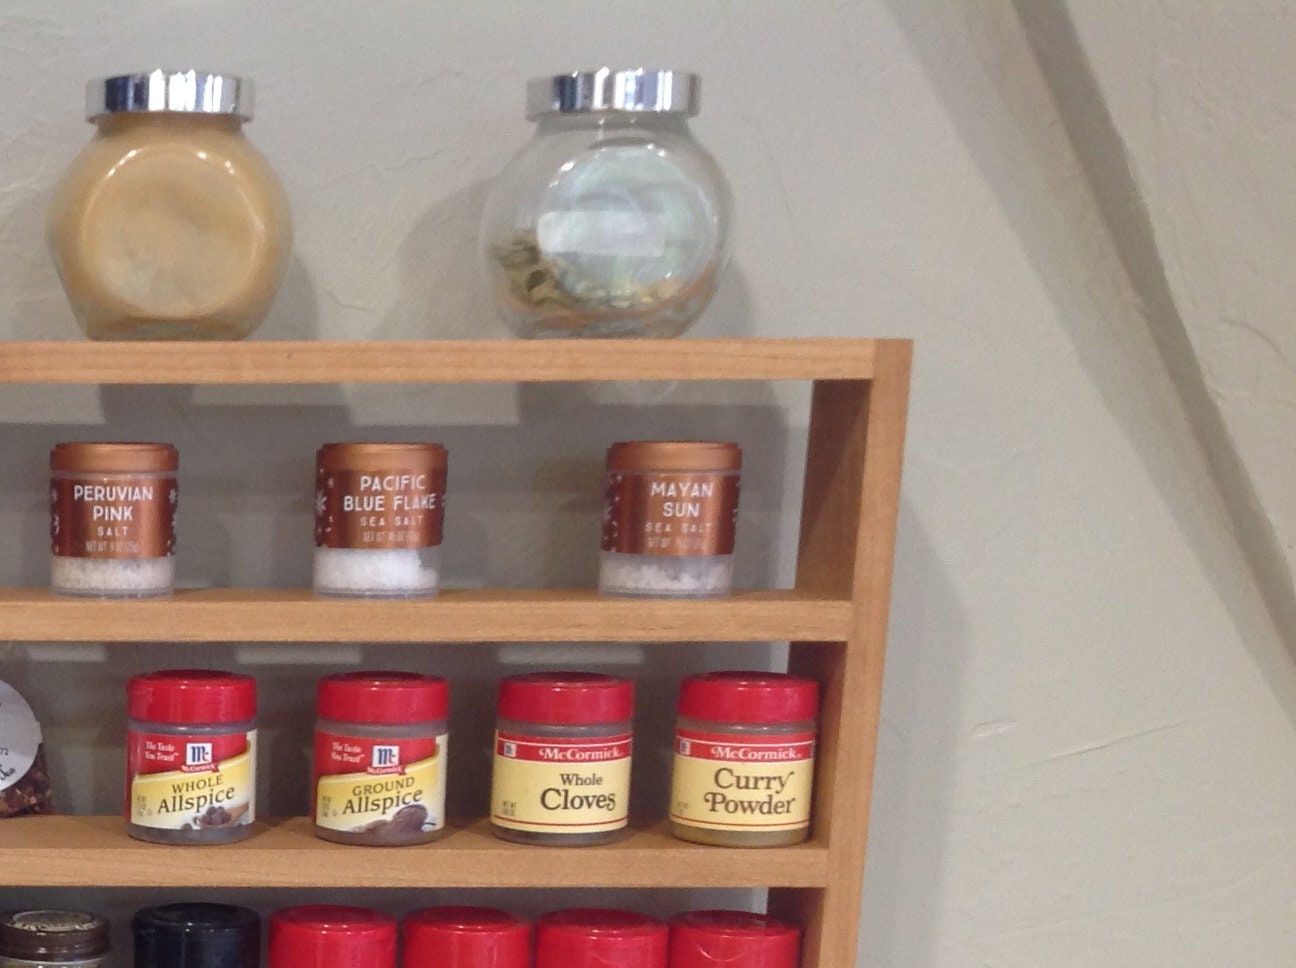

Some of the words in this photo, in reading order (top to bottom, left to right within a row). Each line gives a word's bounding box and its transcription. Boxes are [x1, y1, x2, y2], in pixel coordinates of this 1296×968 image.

[360, 475, 426, 491] PACIFIC
[651, 482, 713, 498] MAYAN
[73, 485, 153, 500] PERUVIAN
[344, 496, 384, 511] BLUE
[393, 494, 436, 510] FLAKE
[663, 502, 699, 517] SUN
[93, 505, 133, 520] PINK
[97, 527, 128, 536] SALT
[645, 523, 671, 532] SEA
[681, 523, 711, 533] SALT
[539, 748, 622, 761] McCormick
[711, 746, 798, 761] McCormick
[172, 774, 224, 794] WHOLE
[352, 776, 416, 796] GROUND
[560, 773, 603, 786] Whole
[714, 768, 795, 794] Curry
[157, 785, 236, 814] Allspice
[342, 788, 423, 816] Allspice
[540, 788, 616, 811] Cloves
[704, 792, 796, 815] Powder
